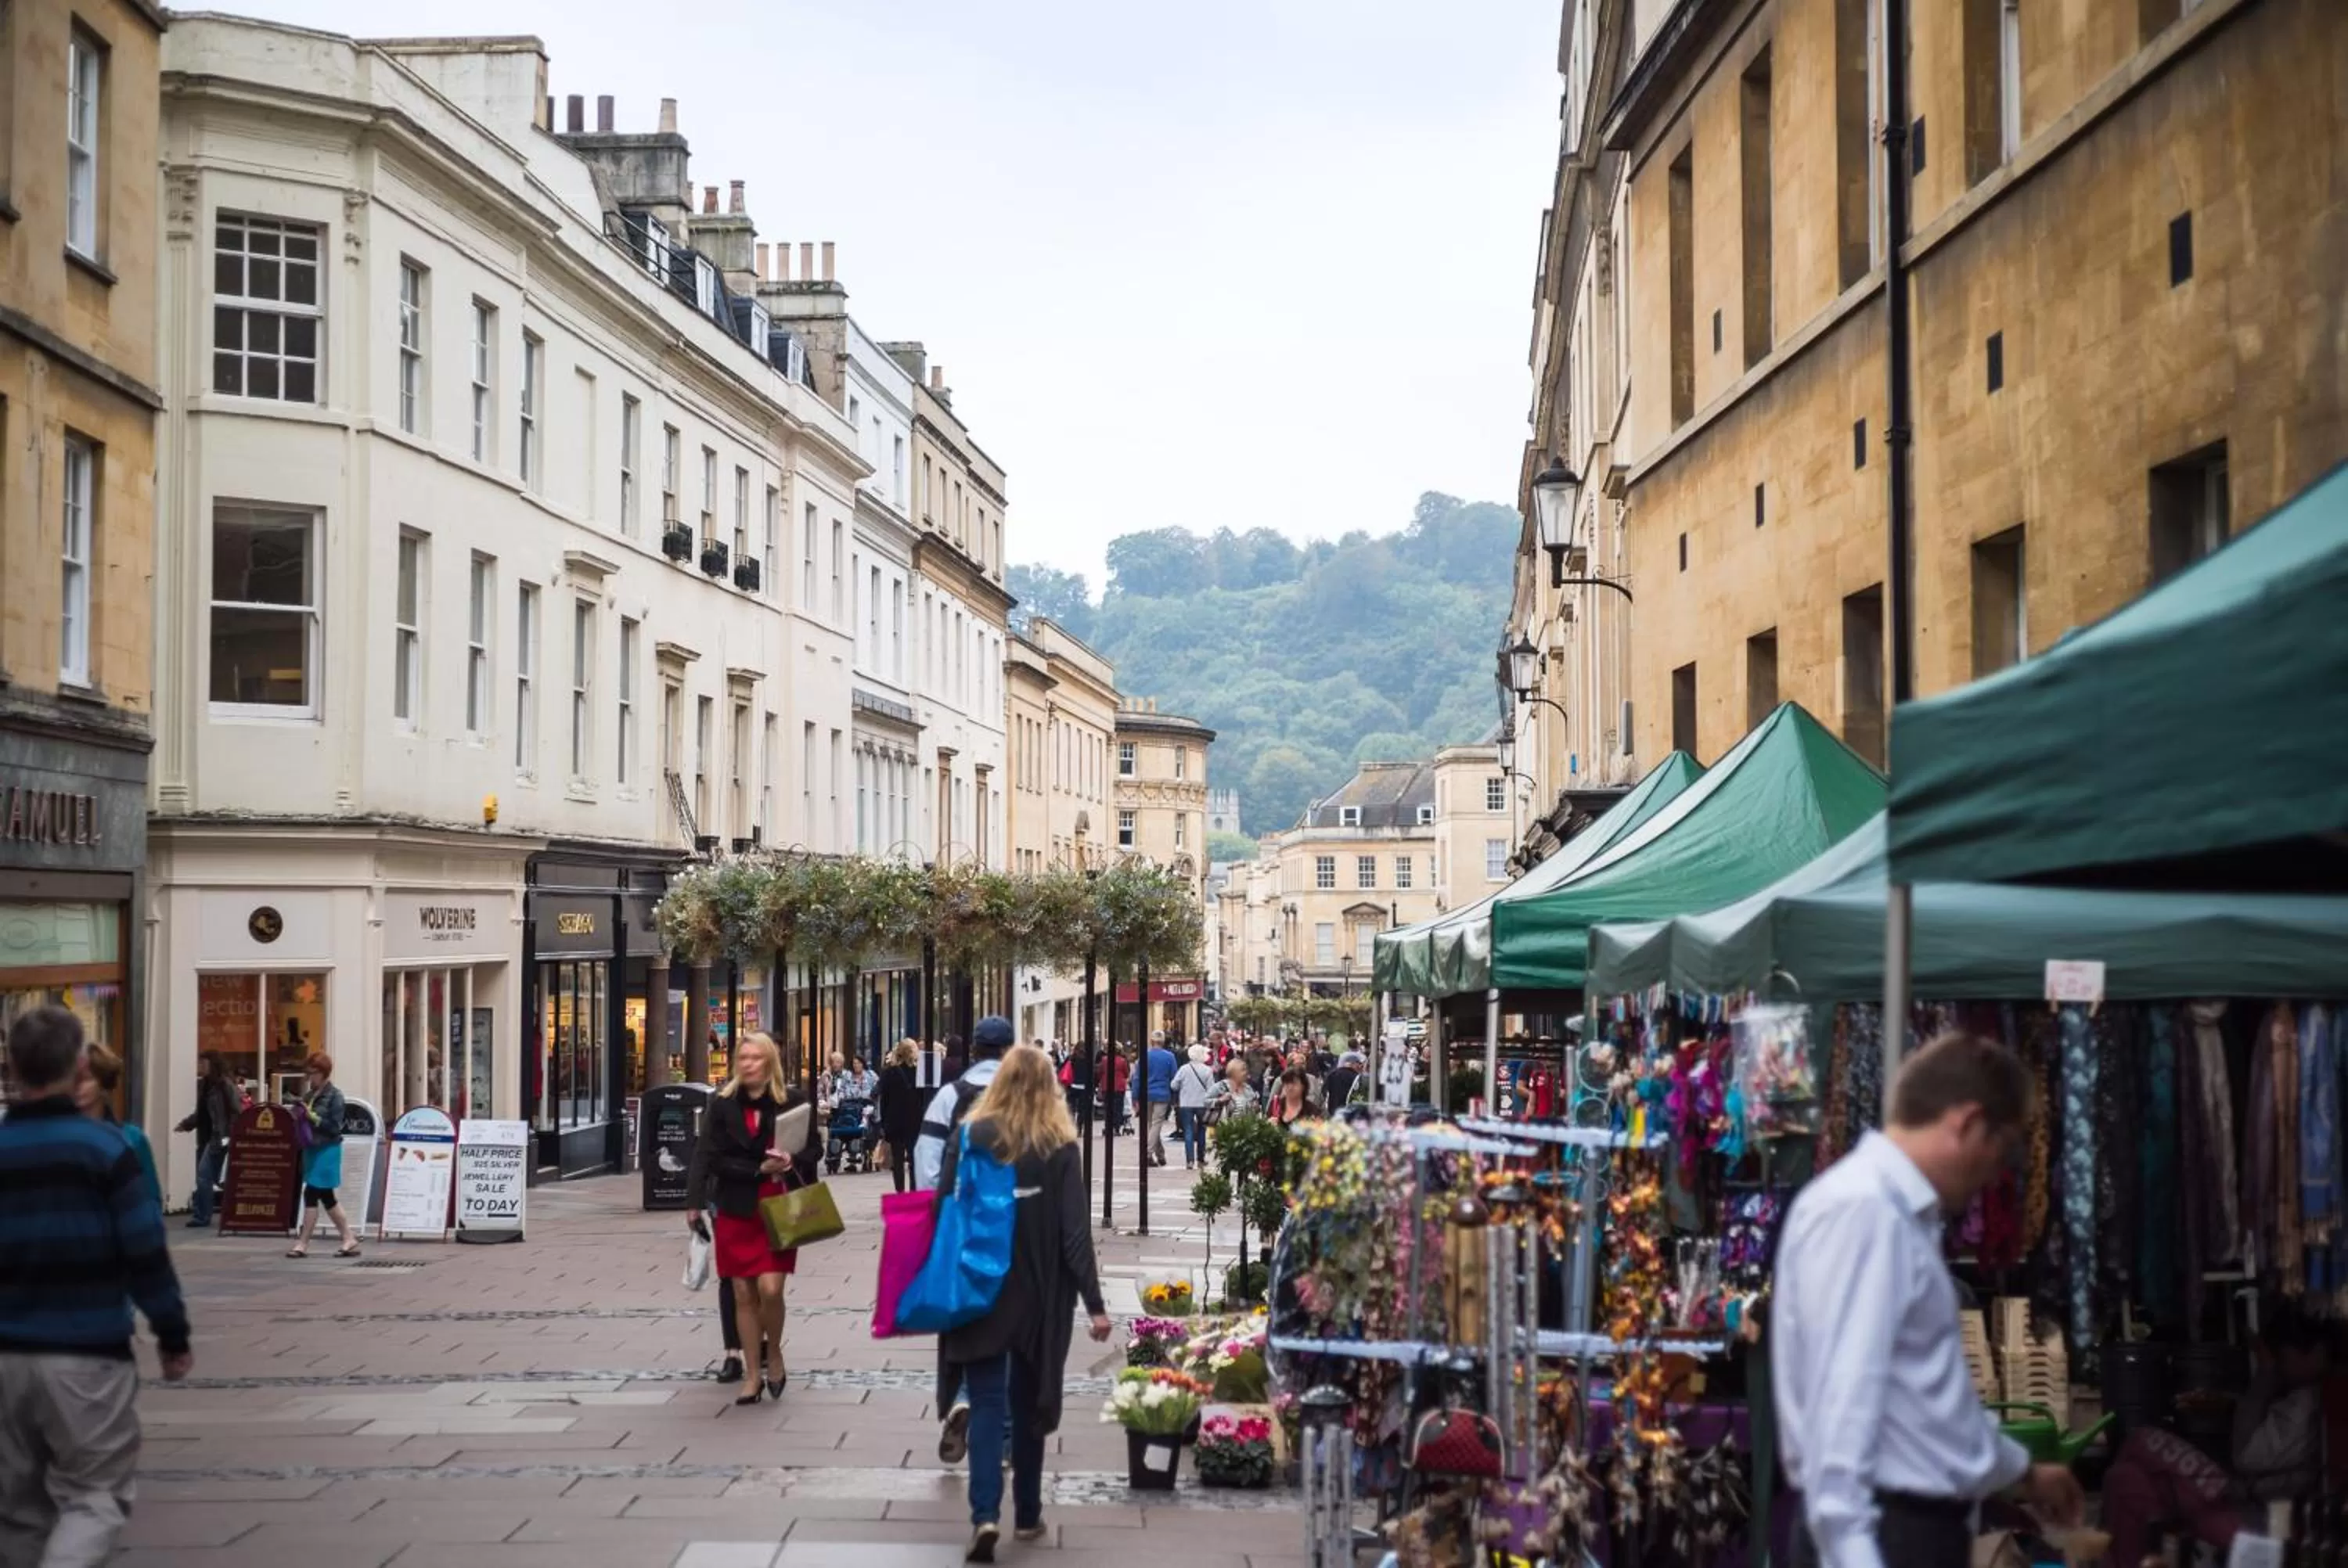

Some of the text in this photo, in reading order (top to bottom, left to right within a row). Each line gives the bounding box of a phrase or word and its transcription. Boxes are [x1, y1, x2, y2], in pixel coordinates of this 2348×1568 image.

[0, 786, 102, 846] AMUEL
[420, 907, 476, 930] WOLVERINE
[461, 1148, 523, 1159] HALF PRICE
[490, 1160, 520, 1169] SILVER
[463, 1173, 515, 1181] JEWELLERY
[475, 1183, 506, 1193] SALE
[465, 1198, 519, 1212] TODAY
